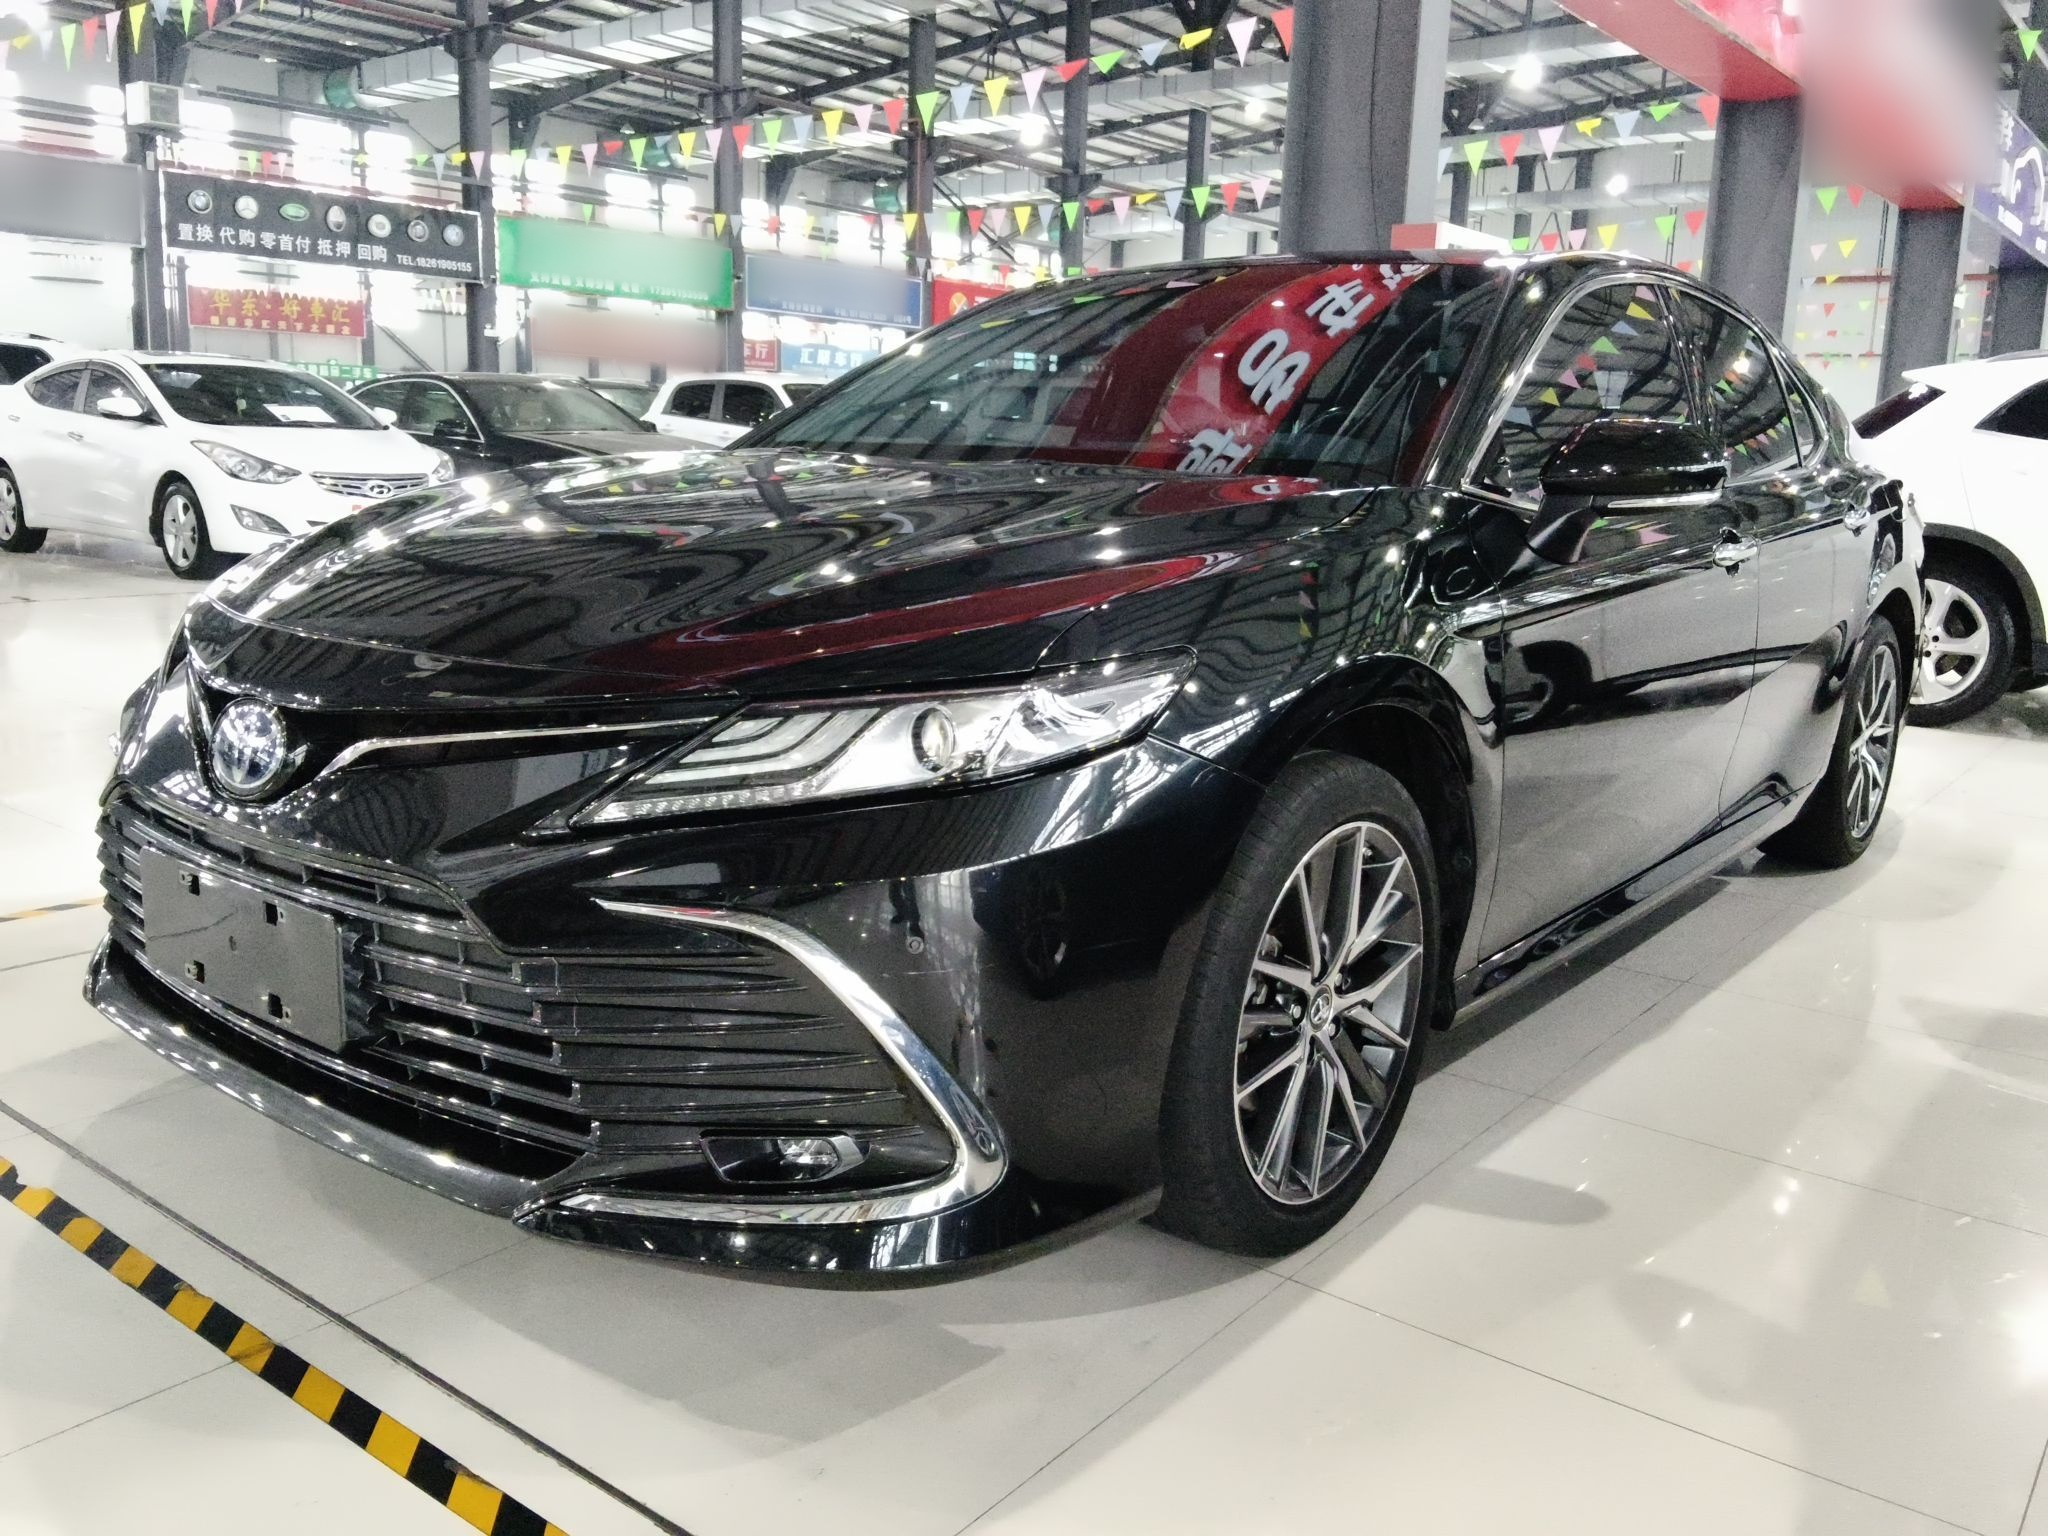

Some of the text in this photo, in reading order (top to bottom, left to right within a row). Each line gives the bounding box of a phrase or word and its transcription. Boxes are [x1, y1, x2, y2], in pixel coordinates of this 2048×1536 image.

[178, 223, 214, 243] 置换
[219, 226, 256, 248] 代购
[260, 231, 311, 254] 零首付
[317, 238, 350, 258] 抵押
[357, 243, 387, 263] 回购
